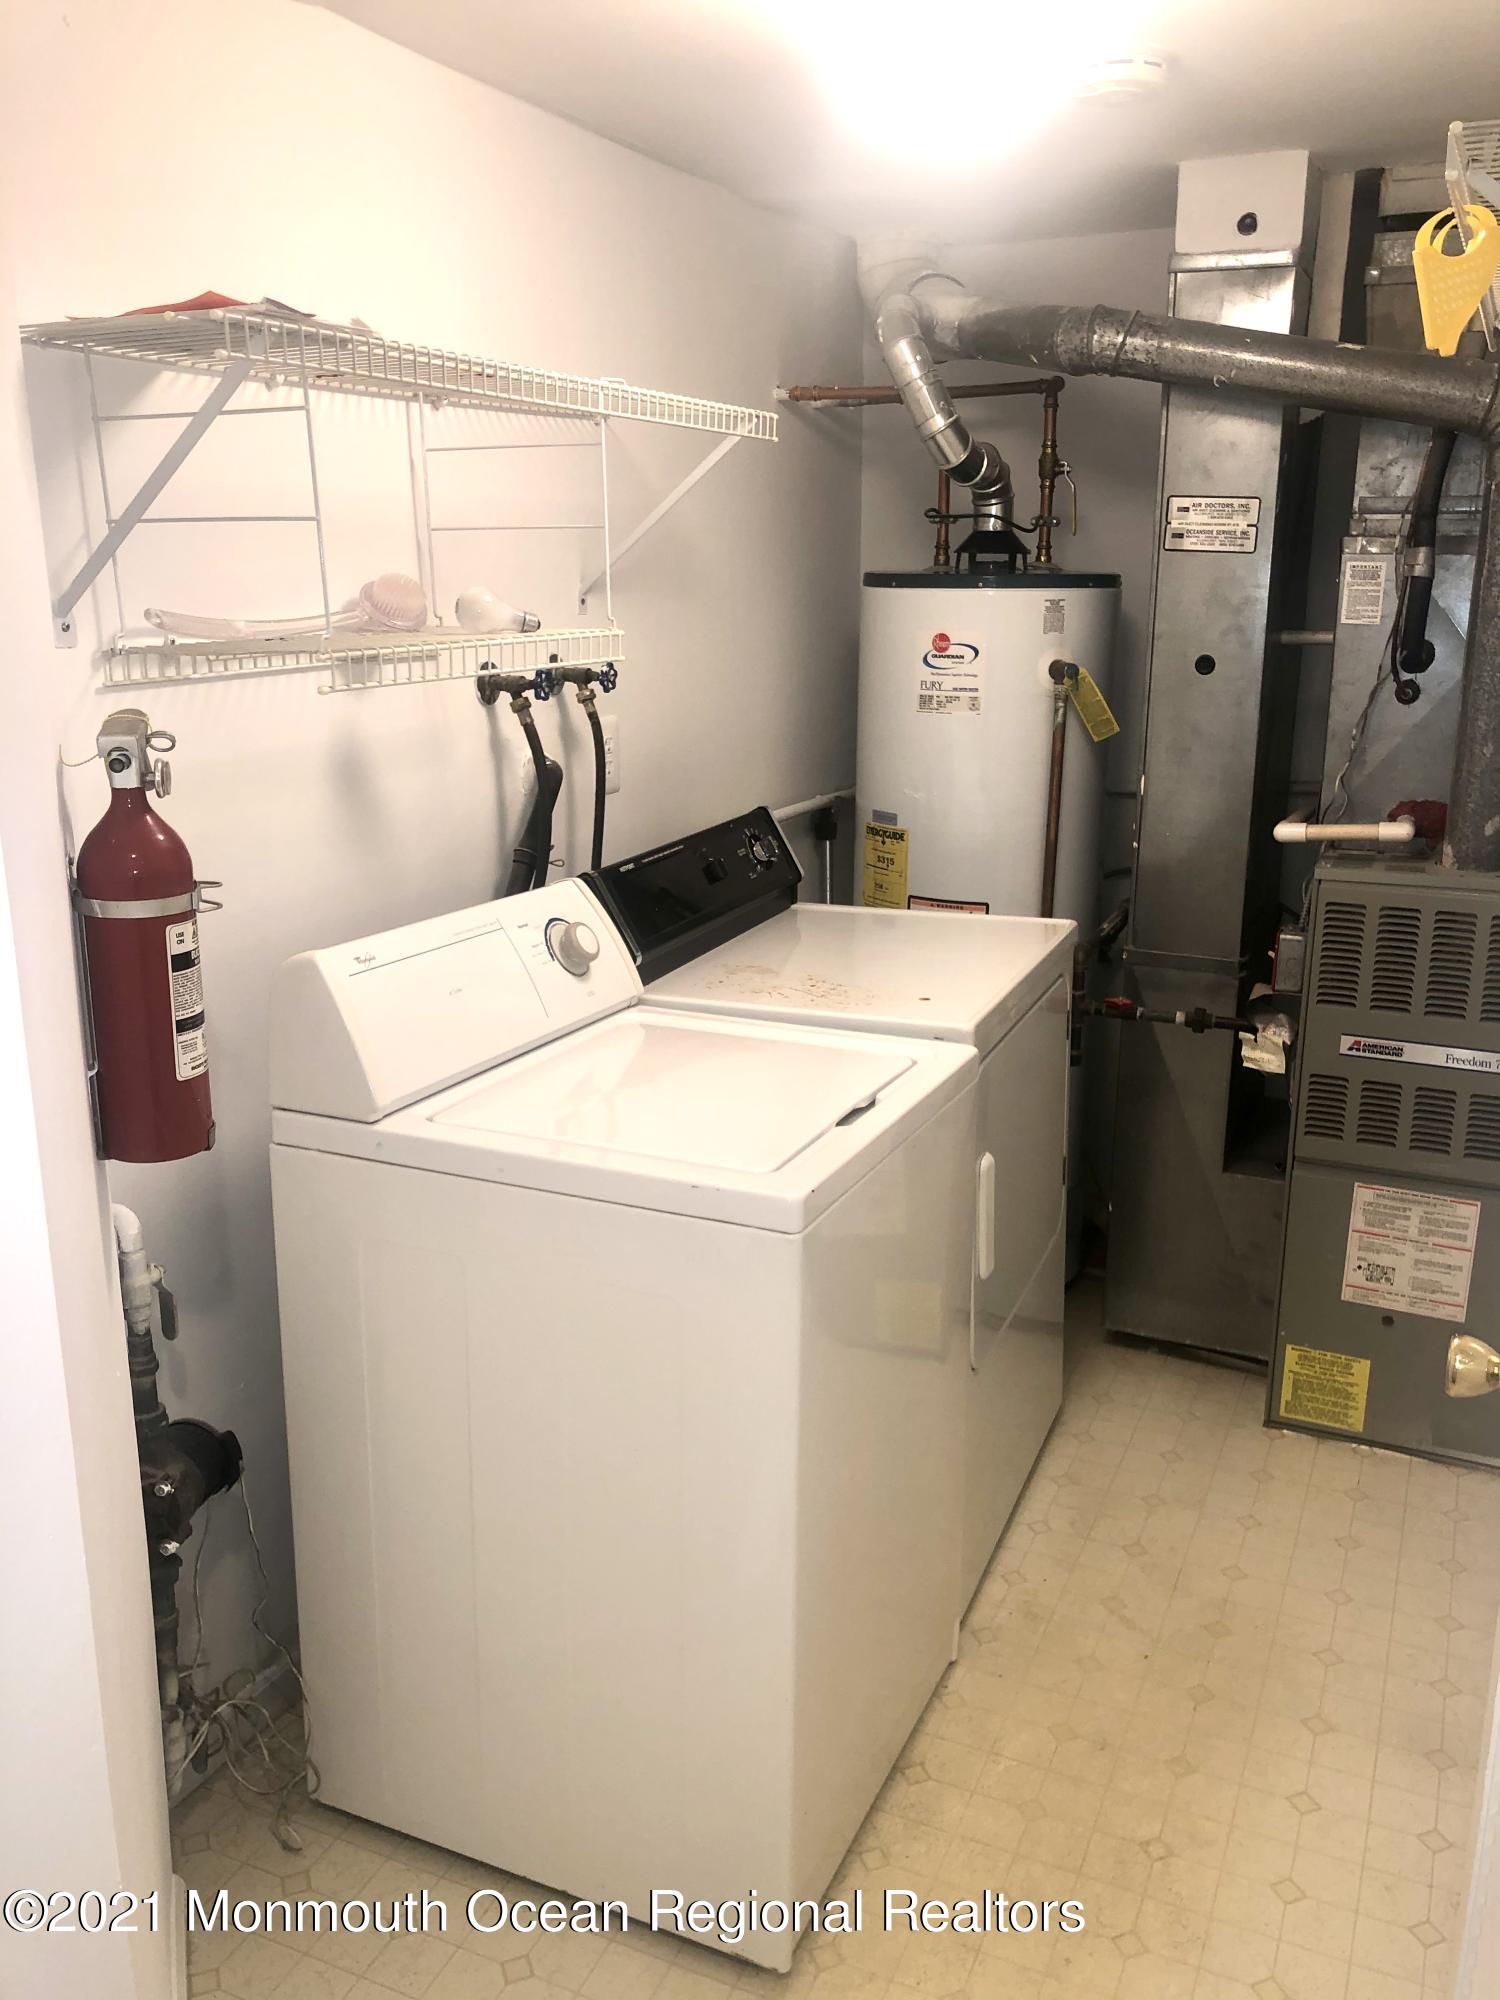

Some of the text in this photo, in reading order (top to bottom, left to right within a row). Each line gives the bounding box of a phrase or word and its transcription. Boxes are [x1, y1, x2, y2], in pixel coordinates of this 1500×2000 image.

[920, 680, 943, 691] FURY
[1362, 1043, 1403, 1052] AMERICAN
[1362, 1048, 1403, 1058] STANDARD
[1445, 1053, 1492, 1069] Freedom
